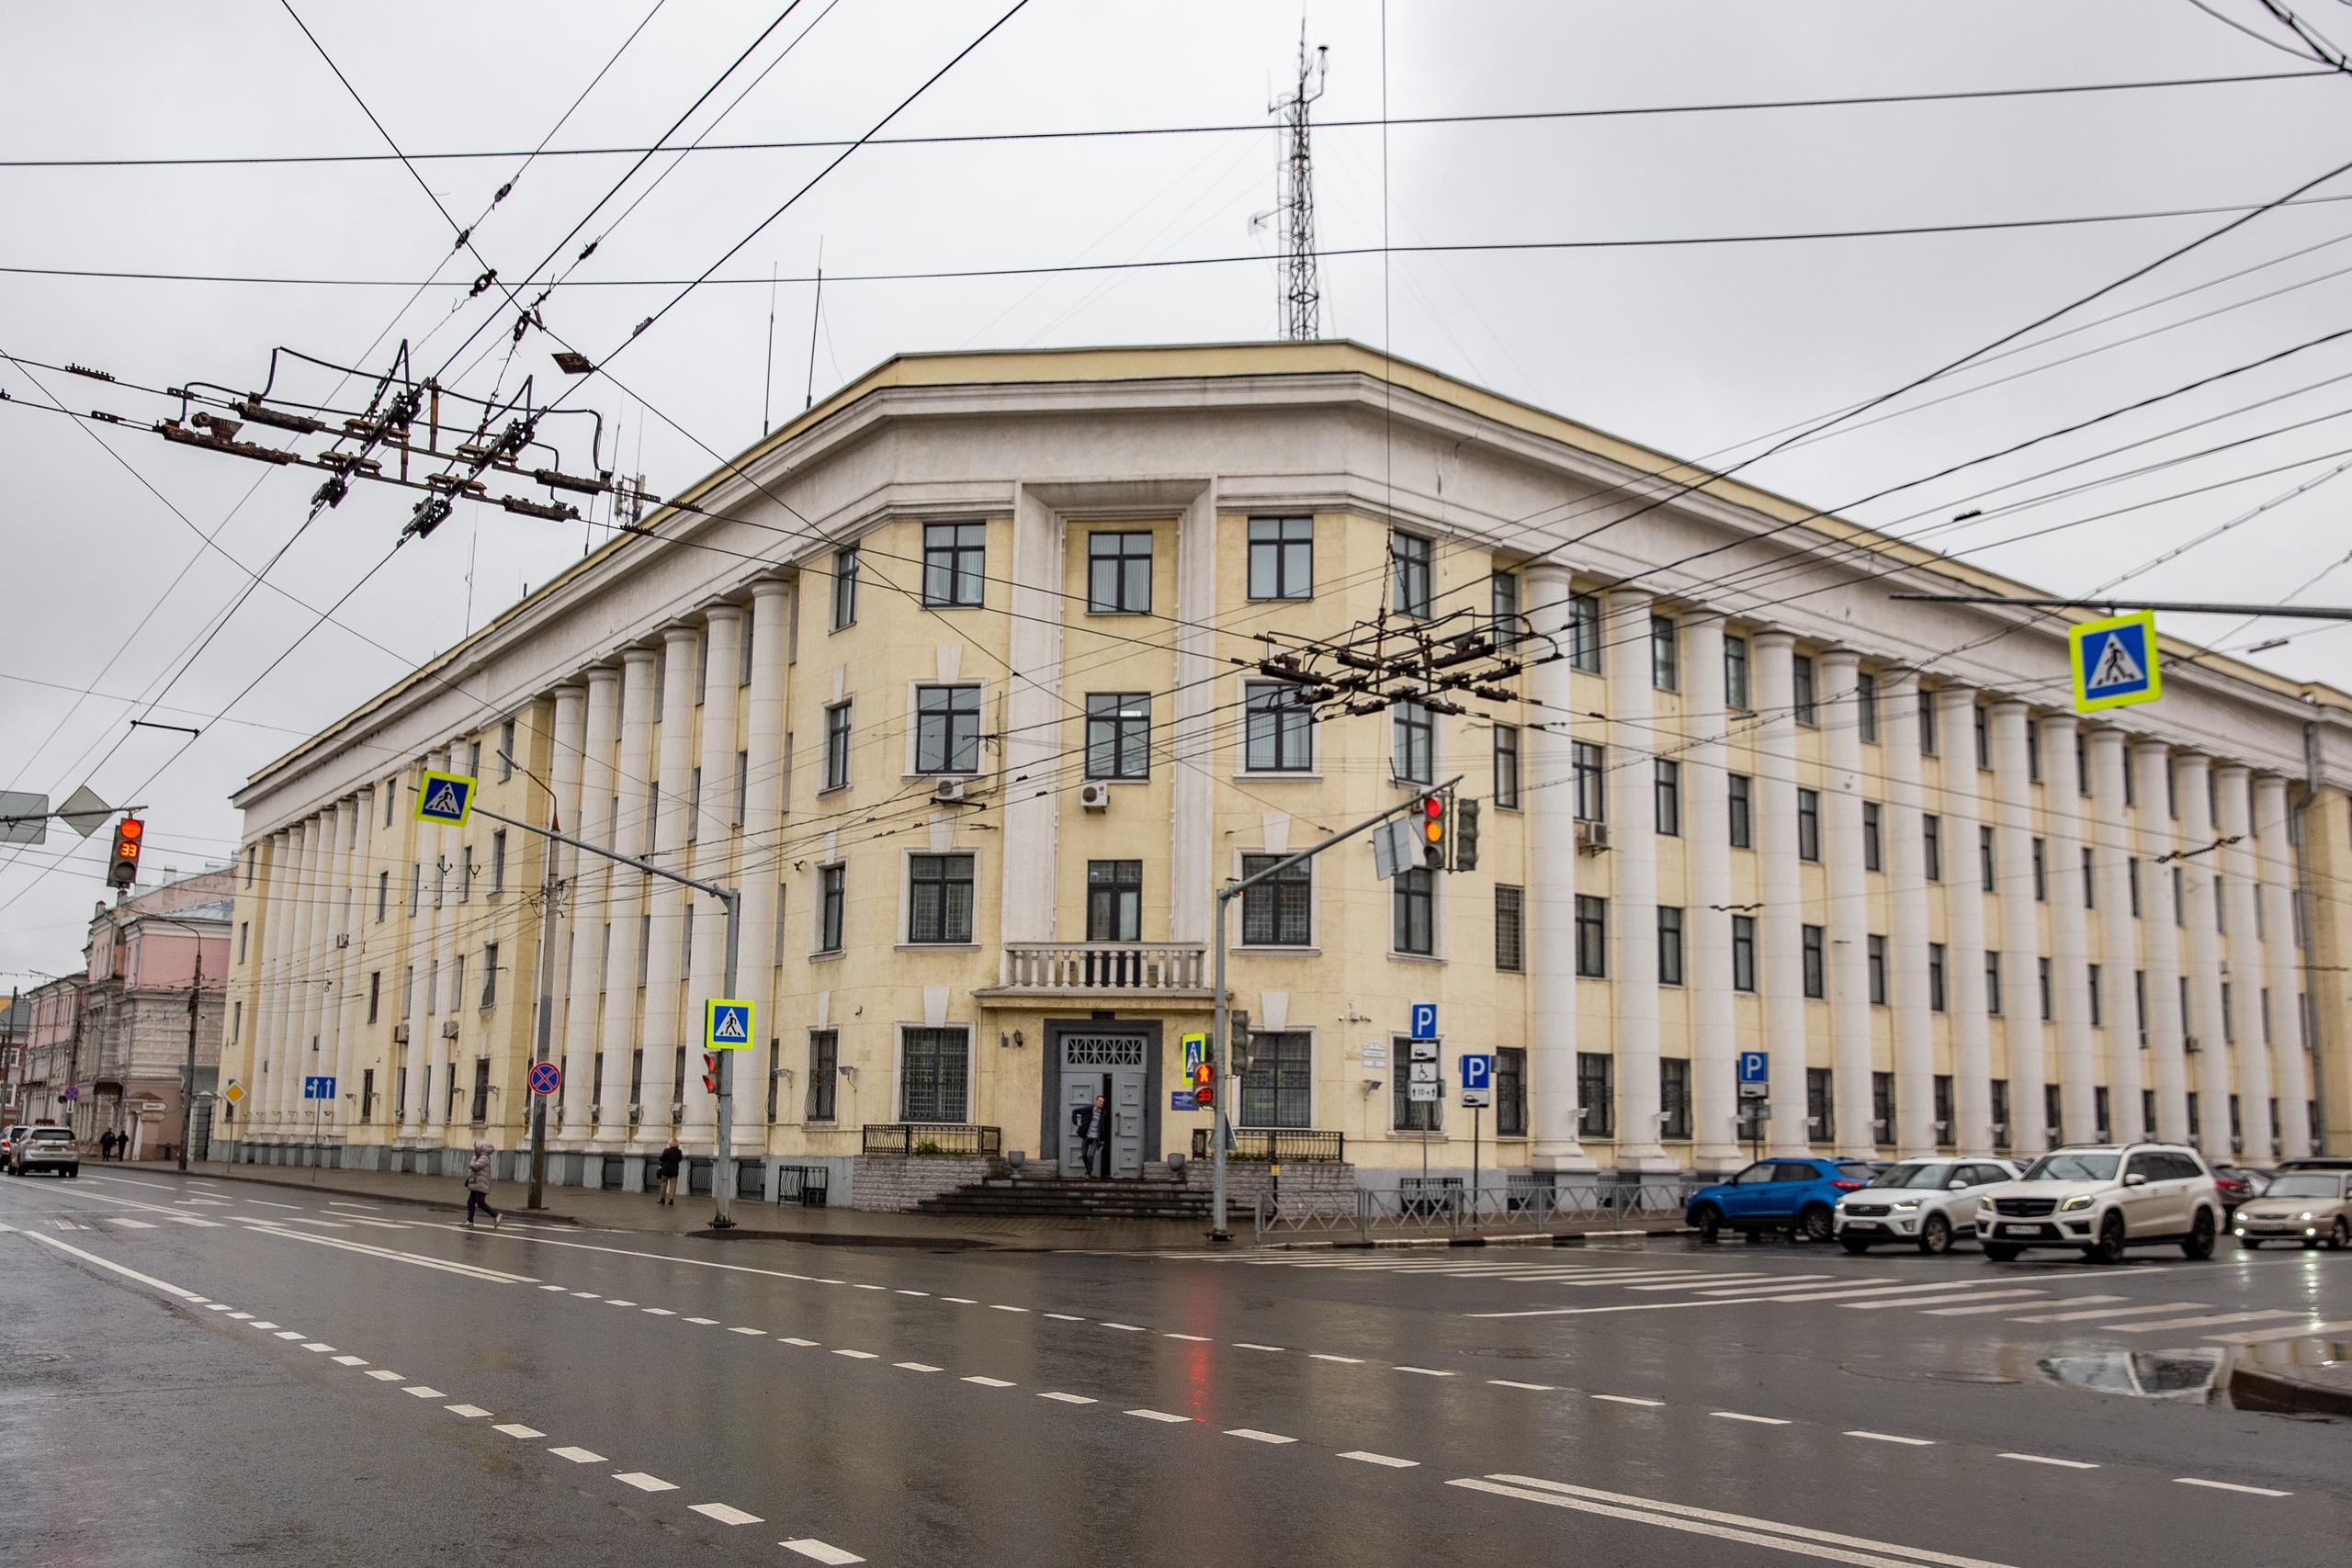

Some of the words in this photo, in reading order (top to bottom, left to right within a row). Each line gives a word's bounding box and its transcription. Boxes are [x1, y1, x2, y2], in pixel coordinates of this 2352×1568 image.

[121, 842, 137, 857] 33
[1418, 1008, 1432, 1035] P
[1469, 1057, 1485, 1086] P
[1747, 1054, 1762, 1078] P
